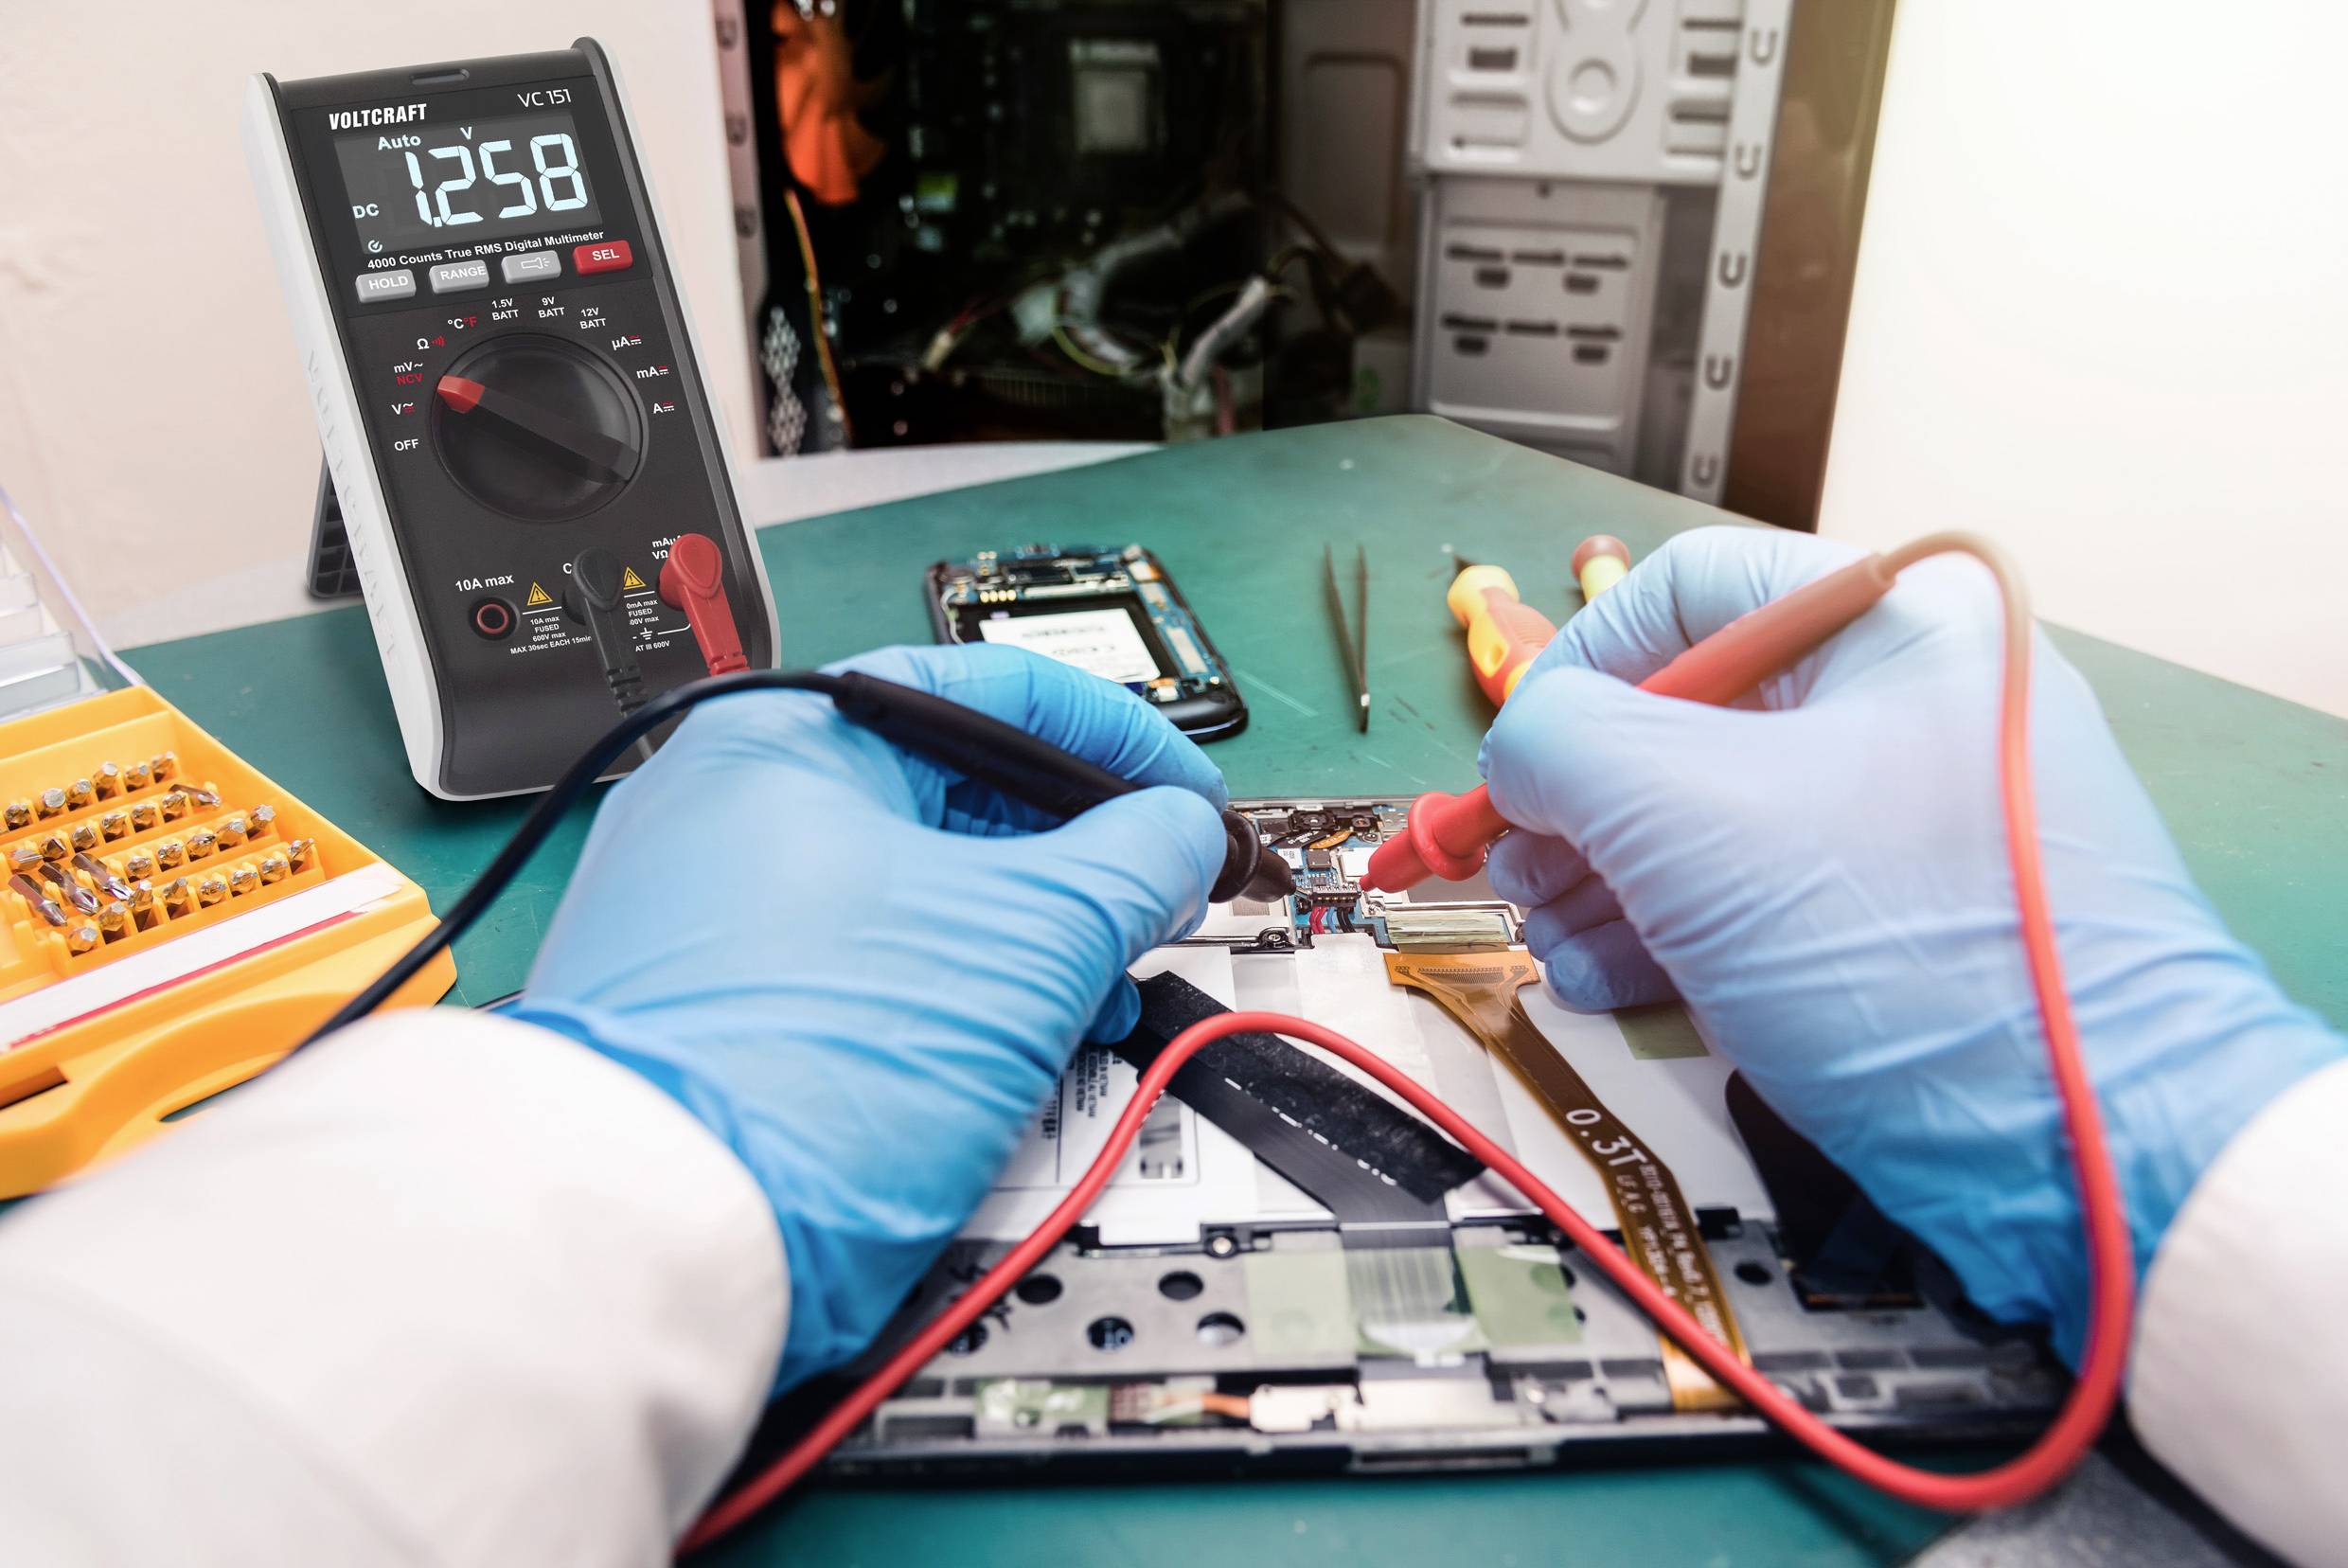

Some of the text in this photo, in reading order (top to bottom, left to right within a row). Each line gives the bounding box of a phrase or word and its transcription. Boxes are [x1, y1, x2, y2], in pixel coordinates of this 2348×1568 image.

[518, 89, 571, 108] VC 151
[329, 103, 426, 131] VOLTCRAFT
[460, 127, 472, 140] V
[378, 134, 421, 151] Auto
[352, 204, 380, 218] DC
[367, 230, 604, 269] 4000 Counts True RMS Digital Multimeter
[592, 248, 619, 261] SEL
[440, 266, 486, 281] RANGE
[368, 276, 408, 290] HOLD
[492, 298, 513, 308] 1.5V
[543, 297, 555, 306] 9V
[492, 310, 519, 320] BATT
[539, 308, 564, 318] BATT
[581, 308, 599, 317] 12V
[580, 318, 606, 330] BATT
[397, 374, 423, 385] NCV
[394, 438, 418, 452] OFF
[455, 574, 514, 592] 10A max
[629, 608, 652, 617] FUSED
[535, 624, 560, 633] FUSED
[533, 633, 550, 642] 600V
[510, 646, 526, 654] MAX
[528, 643, 548, 651] 30sec
[549, 638, 570, 648] EACH
[653, 640, 670, 650] 600V
[1566, 1108, 1647, 1167] 0.3T
